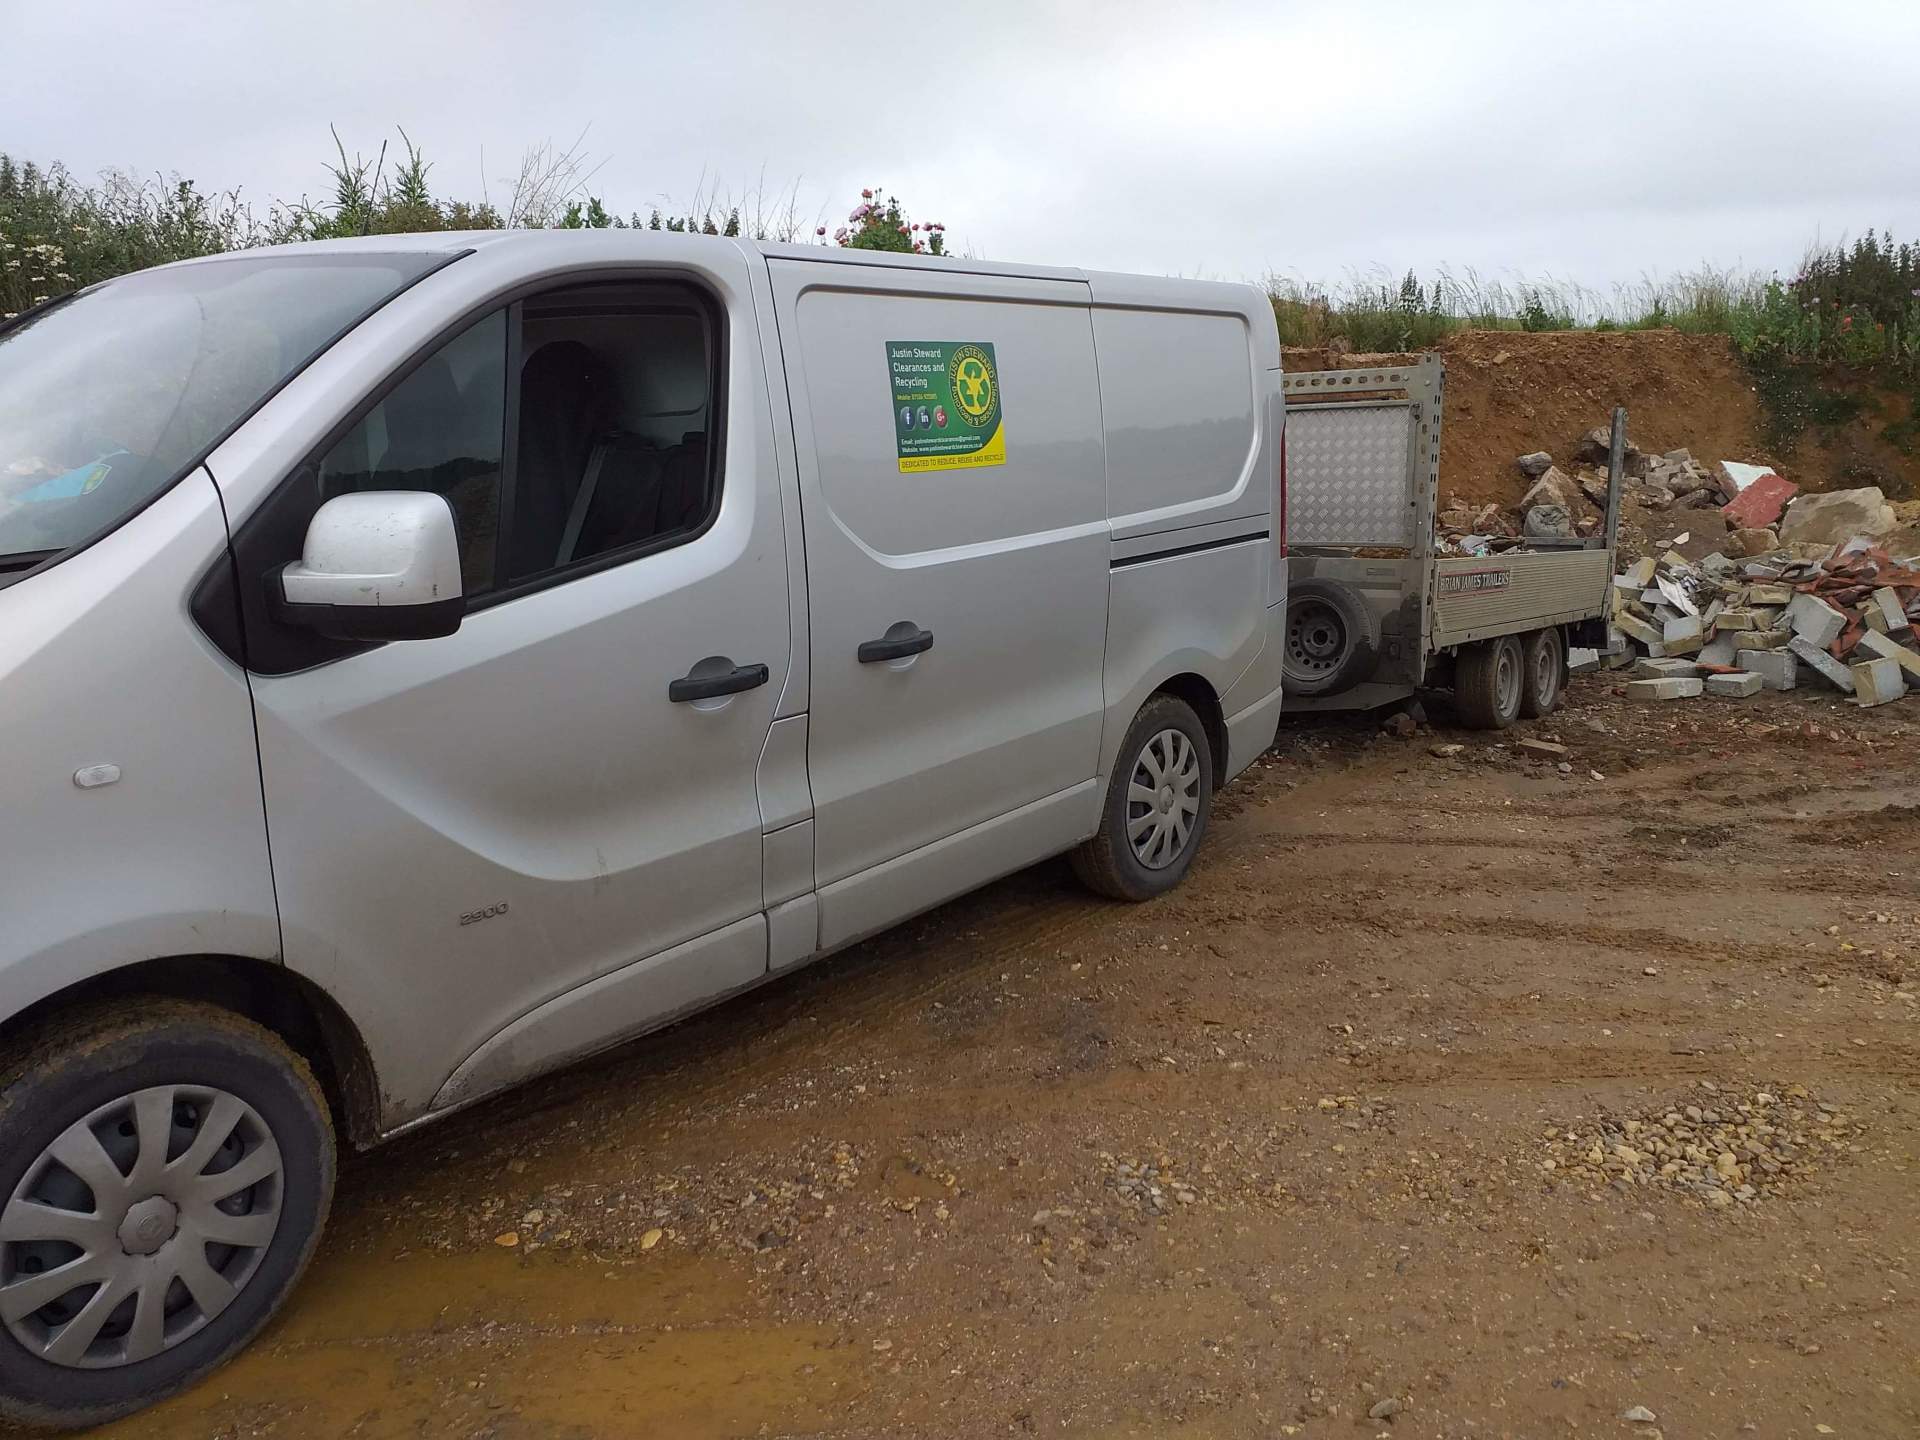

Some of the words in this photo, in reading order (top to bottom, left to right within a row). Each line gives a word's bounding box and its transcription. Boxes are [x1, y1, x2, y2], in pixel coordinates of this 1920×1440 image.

[892, 348, 913, 358] Justin
[914, 348, 942, 358] Steward
[893, 362, 932, 372] Clearances
[933, 362, 945, 372] and
[951, 351, 965, 382] JUSTIN
[965, 347, 995, 379] STEWARD
[895, 376, 928, 389] Recycling
[901, 460, 930, 469] DEDICATED
[974, 455, 984, 463] AND
[1440, 576, 1461, 591] BRIAN
[1460, 574, 1481, 592] JAMES
[1482, 571, 1509, 588] TRAILERS
